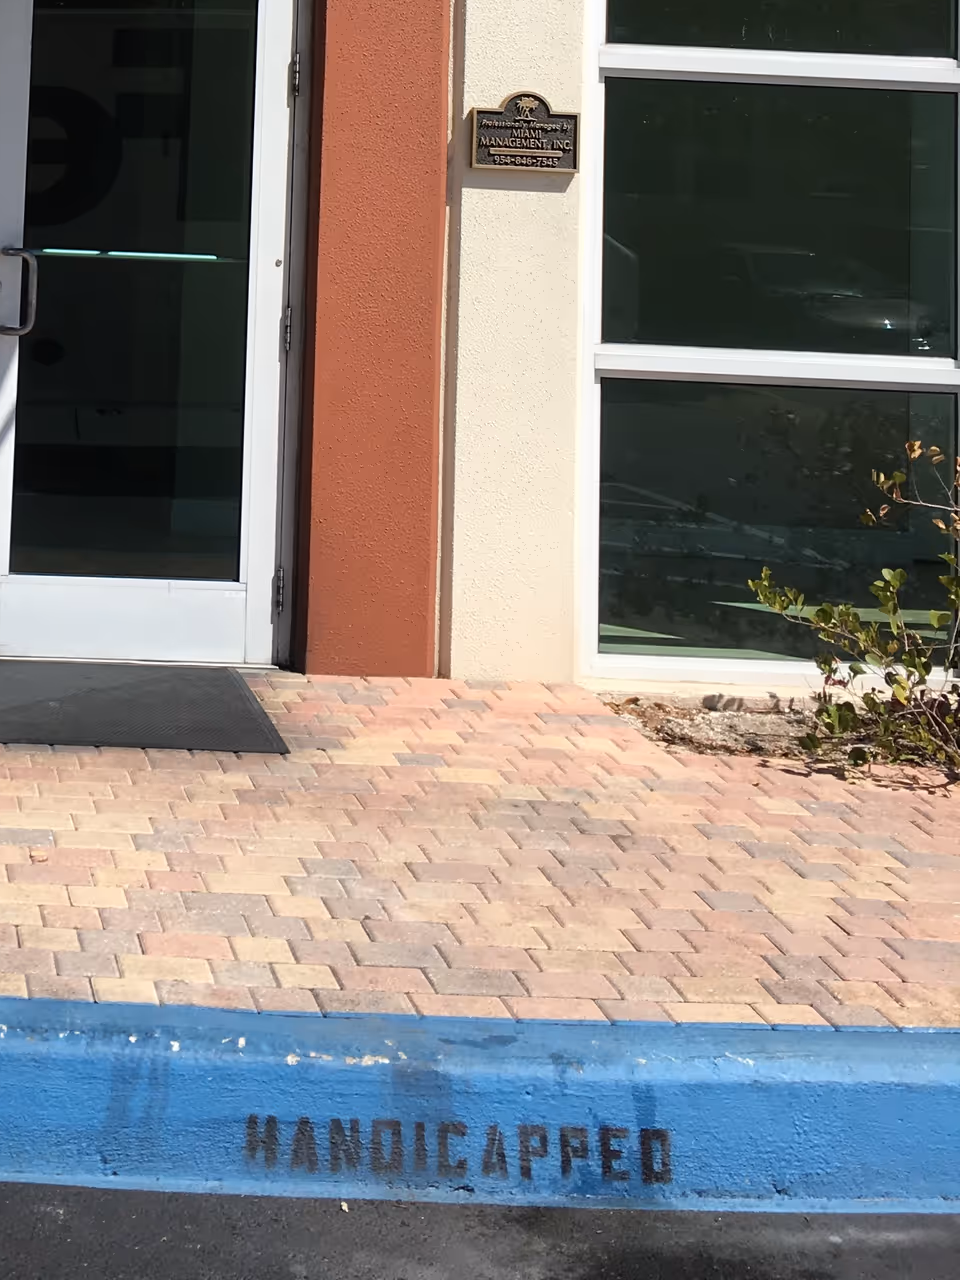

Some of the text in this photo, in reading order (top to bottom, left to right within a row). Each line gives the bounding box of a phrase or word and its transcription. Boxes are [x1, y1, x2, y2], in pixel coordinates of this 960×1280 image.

[481, 120, 572, 131] Professionally Managed by
[511, 128, 542, 139] MIAMI
[553, 140, 573, 150] INC.
[494, 155, 559, 167] 954-846-7545
[244, 1113, 673, 1184] HANDICAPPED
